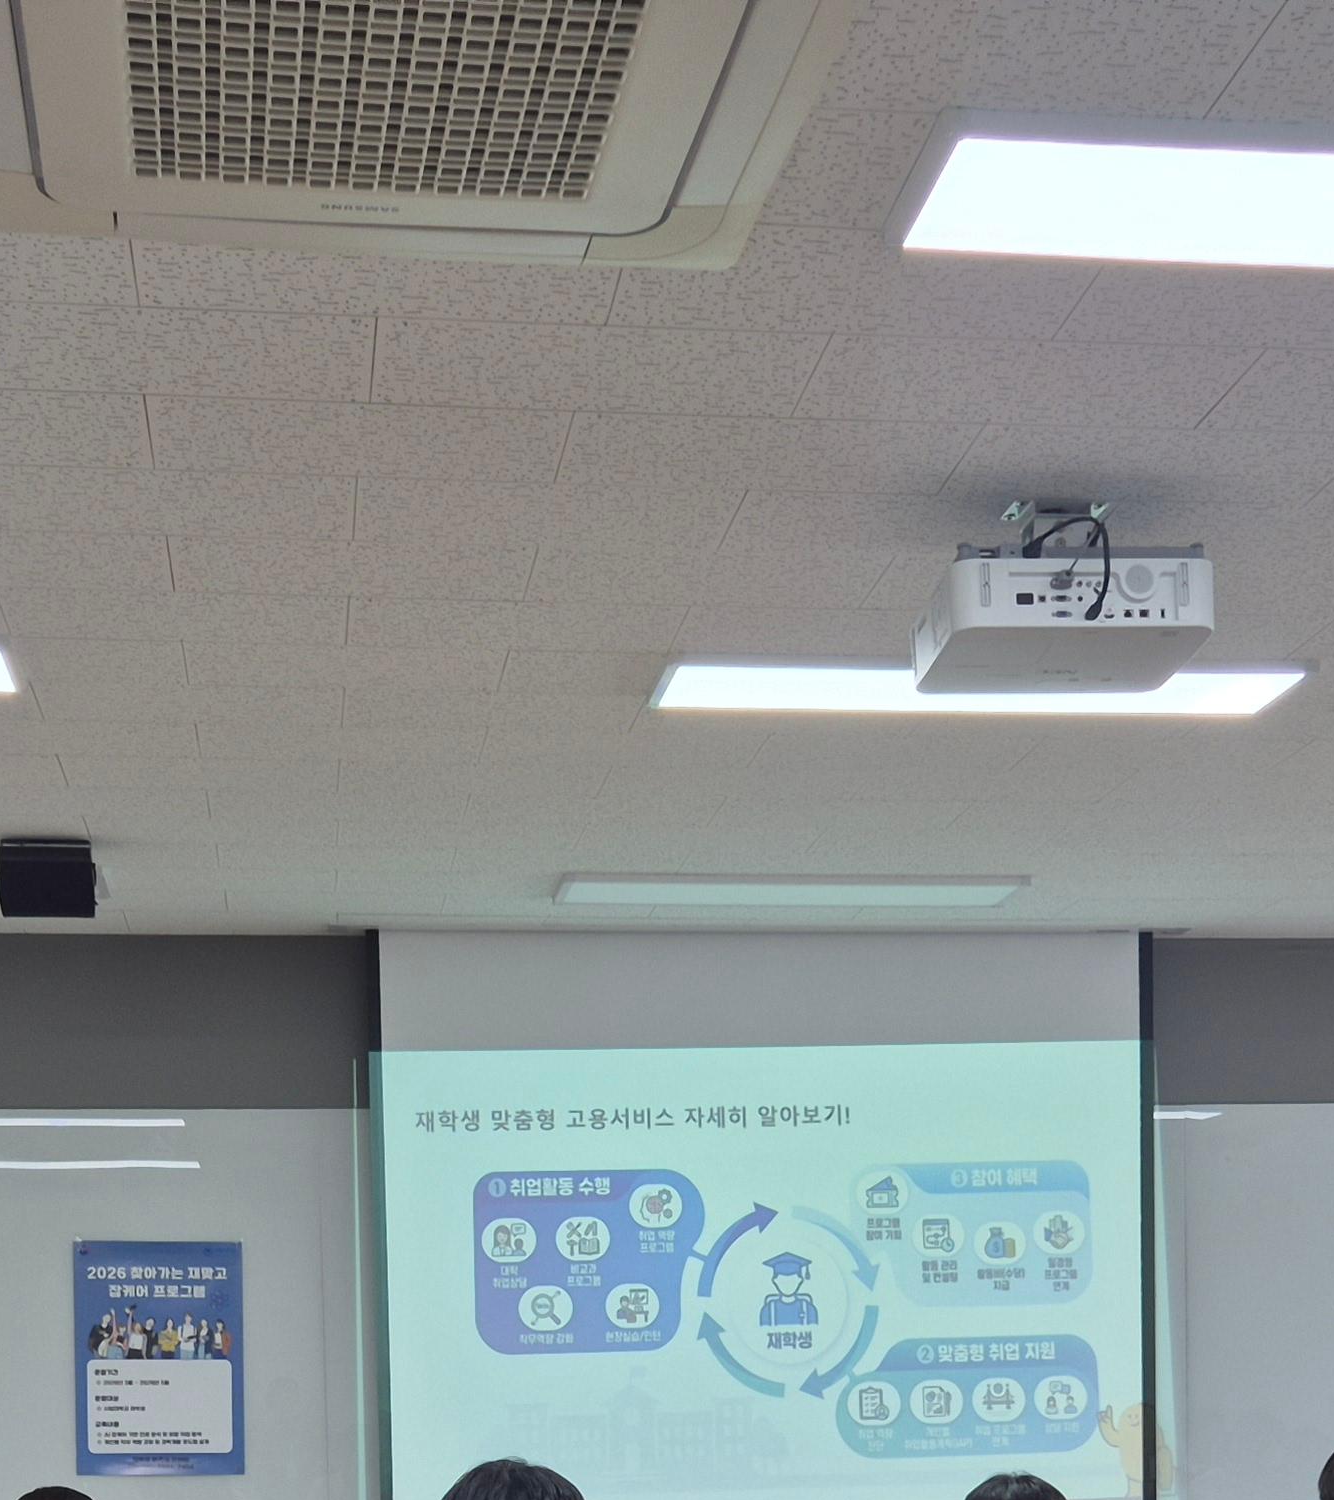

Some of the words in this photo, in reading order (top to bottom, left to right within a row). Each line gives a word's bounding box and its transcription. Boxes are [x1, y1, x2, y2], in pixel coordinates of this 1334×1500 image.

[415, 1109, 481, 1133] 재학생
[491, 1108, 555, 1132] 맞춤형
[566, 1106, 674, 1130] 고용서비스
[684, 1105, 747, 1129] 자세히
[757, 1104, 851, 1128] 알아보기!
[971, 1168, 1003, 1187] 참여
[1007, 1167, 1038, 1186] 혜택
[510, 1177, 574, 1197] 취업활동
[578, 1176, 611, 1196] 수행
[640, 1242, 675, 1254] 프로그램
[87, 1266, 127, 1280] 2026
[130, 1266, 184, 1280] 찾아가는
[570, 1264, 597, 1275] 비교과
[567, 1276, 602, 1287] 프로그램
[109, 1284, 149, 1298] 잡케어
[153, 1284, 206, 1299] 프로그램
[767, 1331, 813, 1350] 재학생
[938, 1344, 985, 1363] 맞춤형
[989, 1343, 1019, 1362] 취업
[1025, 1342, 1056, 1361] 지원
